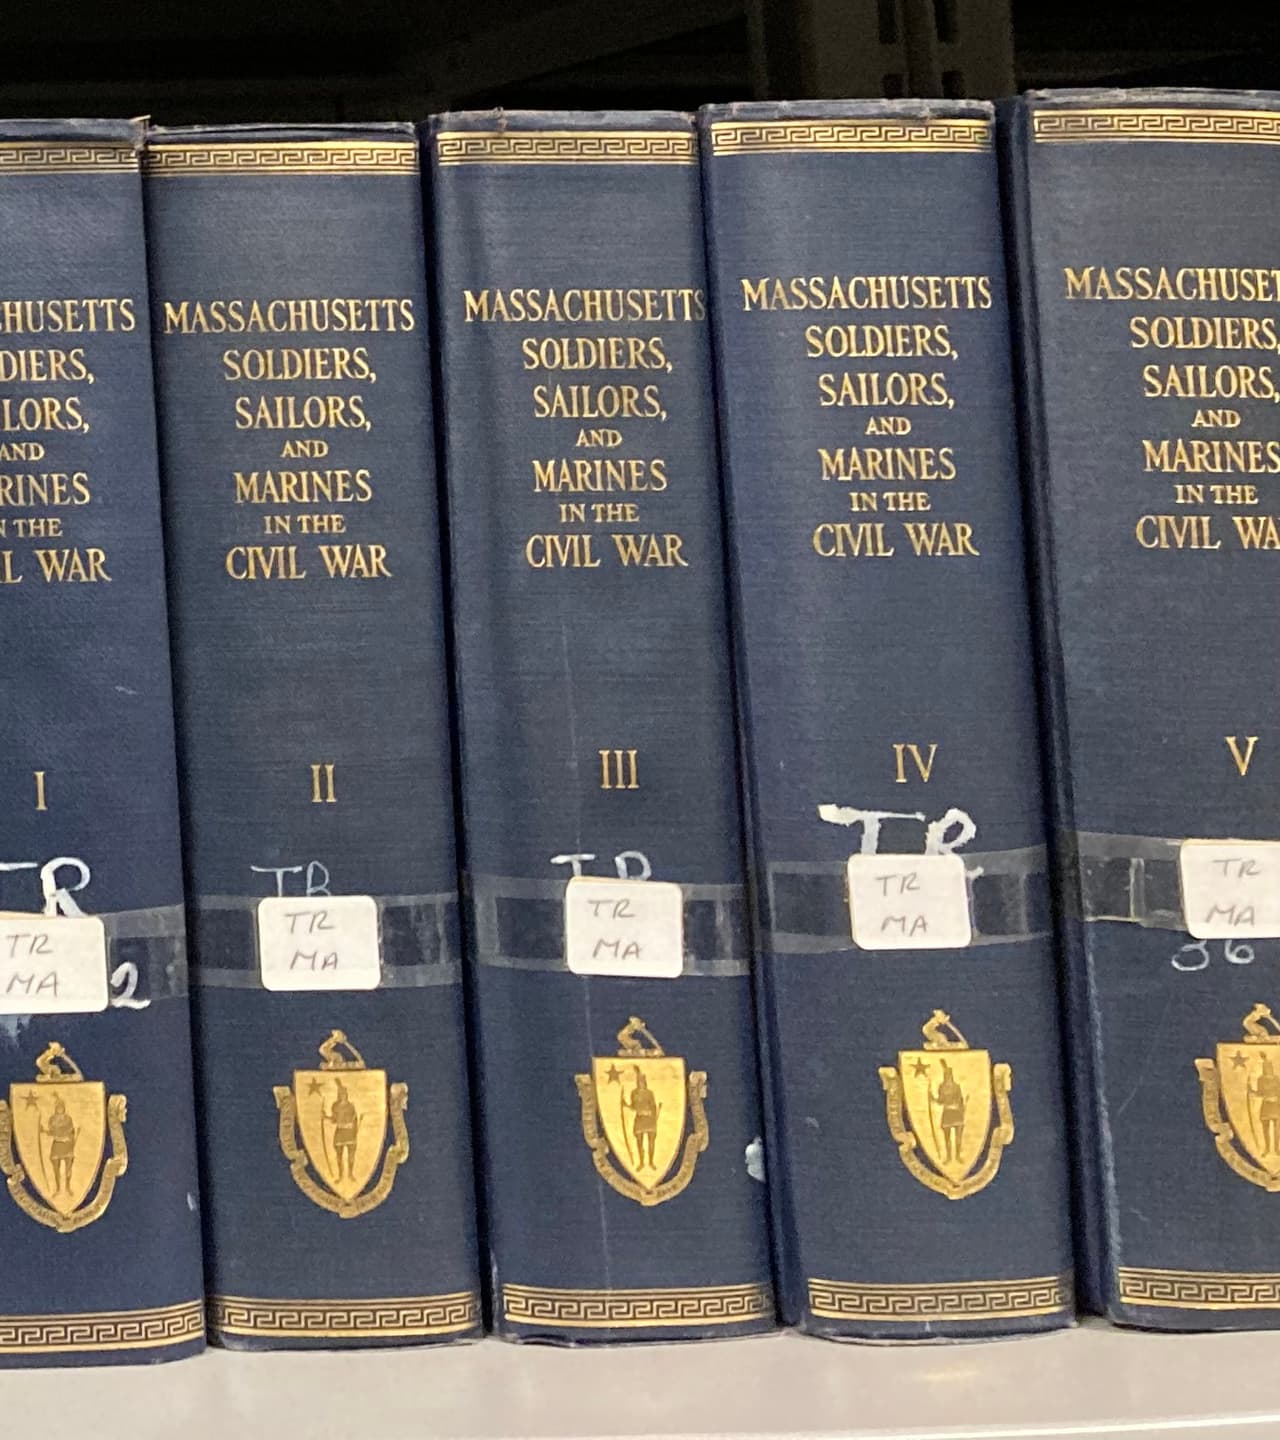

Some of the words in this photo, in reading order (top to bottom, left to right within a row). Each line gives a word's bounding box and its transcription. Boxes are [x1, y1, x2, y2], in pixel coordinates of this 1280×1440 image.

[13, 518, 62, 538] THE
[1135, 515, 1221, 549] CIVIL
[36, 548, 112, 582] WAR
[894, 742, 939, 783] IV
[35, 771, 47, 810] I
[1214, 859, 1262, 878] TR
[1206, 905, 1255, 926] MA
[6, 934, 52, 956] TR
[6, 972, 60, 998] MA
